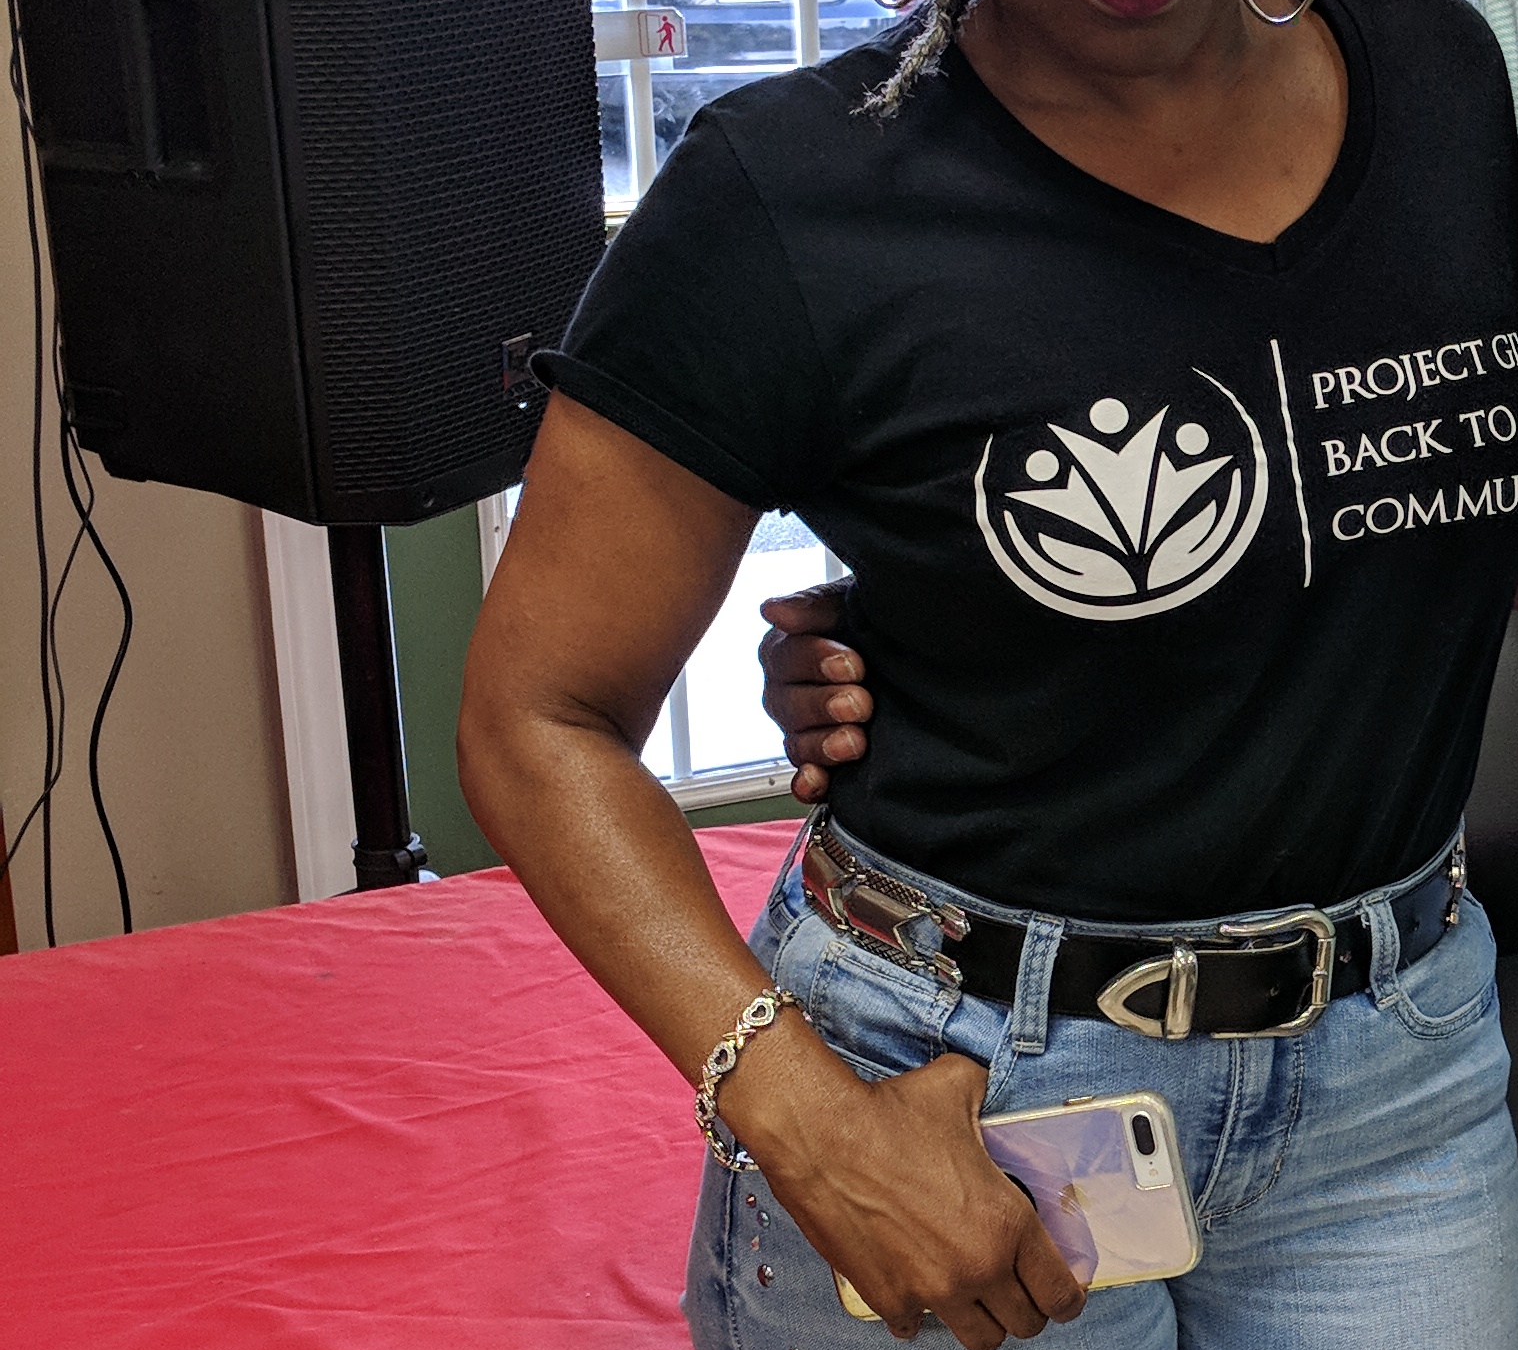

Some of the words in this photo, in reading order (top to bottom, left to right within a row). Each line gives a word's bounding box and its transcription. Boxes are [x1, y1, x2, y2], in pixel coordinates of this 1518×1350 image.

[1312, 338, 1488, 411] PROJECT
[1322, 418, 1453, 478] BACK
[1458, 404, 1518, 448] TO
